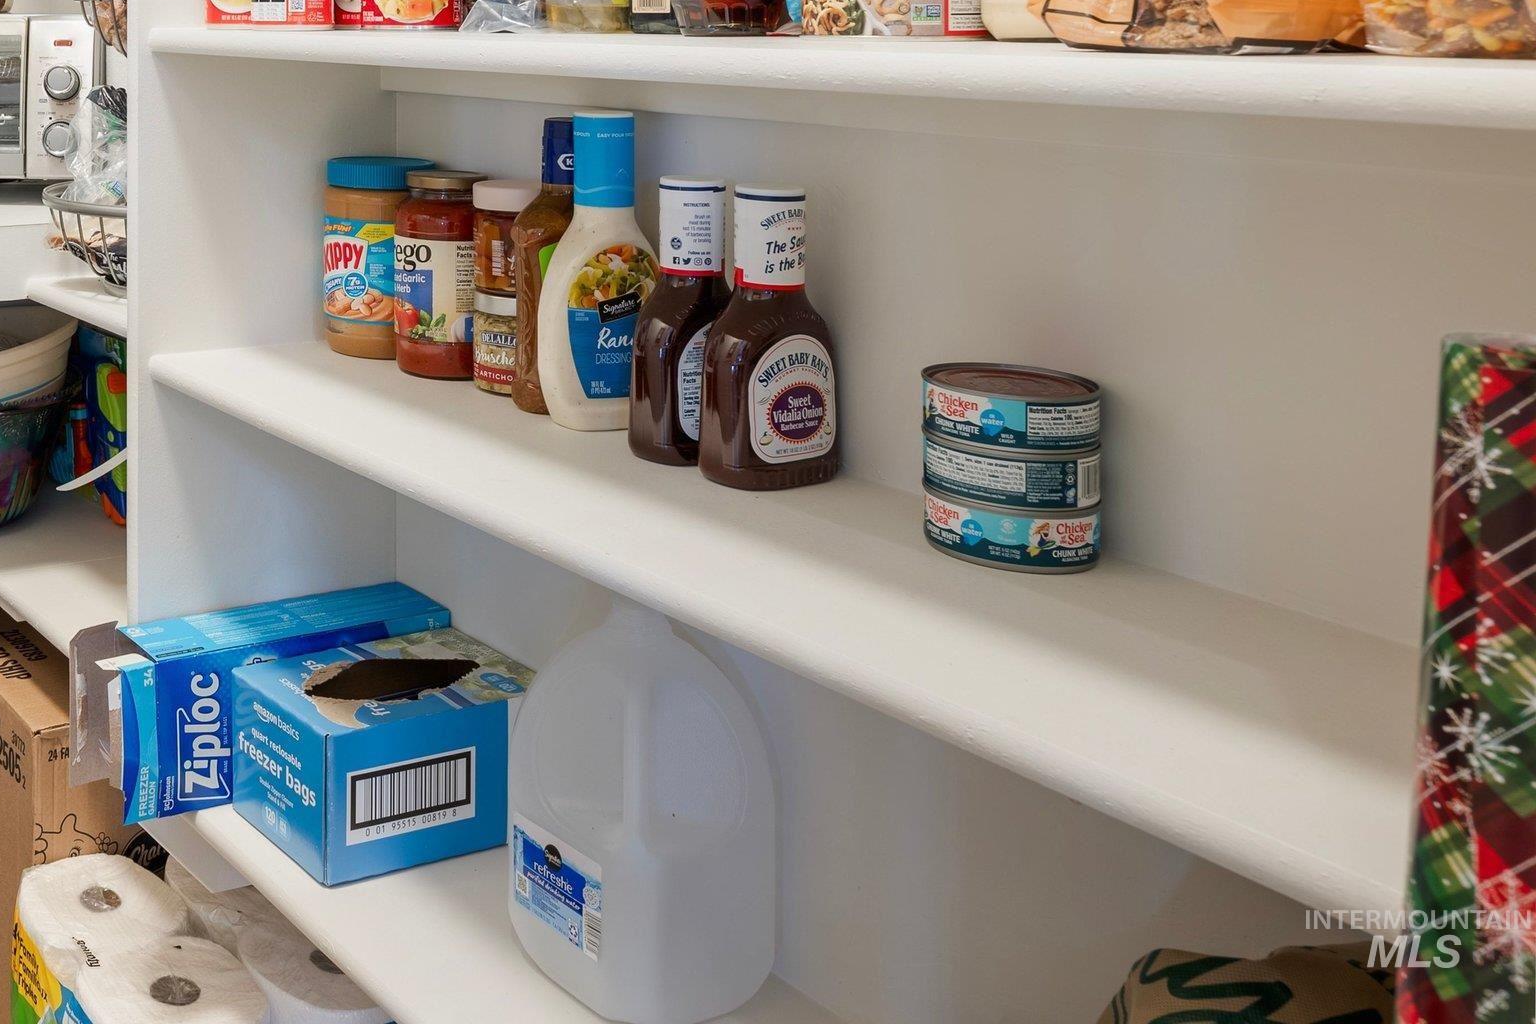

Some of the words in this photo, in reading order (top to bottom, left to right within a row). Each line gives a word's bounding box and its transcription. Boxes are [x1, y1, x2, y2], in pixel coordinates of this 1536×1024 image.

[759, 209, 786, 231] SWEET
[766, 241, 787, 255] The
[765, 259, 775, 274] is
[779, 255, 796, 271] the
[402, 273, 426, 283] Garlic
[603, 298, 636, 314] Signature
[595, 352, 632, 365] DRESSING
[758, 357, 786, 388] SWEET
[787, 352, 810, 367] BABY
[811, 354, 830, 379] RAY'S
[787, 394, 812, 409] Sweet
[937, 391, 979, 412] Chicken
[773, 409, 802, 424] Vidalia
[803, 405, 823, 420] Onion
[946, 405, 965, 419] Sea
[780, 422, 805, 432] Barbecue
[805, 419, 819, 428] Sauce
[934, 416, 956, 429] CHUNK
[956, 422, 980, 435] WHITE
[980, 417, 1005, 427] water
[928, 497, 960, 520] Chicken
[934, 513, 949, 526] Sea
[1056, 521, 1093, 536] Chicken
[941, 531, 961, 544] WHITE
[1068, 533, 1086, 546] Sea
[1052, 549, 1077, 558] CHUNK
[1077, 547, 1093, 555] WHITE
[144, 668, 154, 687] 34
[183, 671, 231, 794] Ziploc
[251, 727, 269, 746] quart
[269, 739, 302, 771] reclosable
[238, 730, 283, 779] freezer
[285, 764, 317, 807] bags
[138, 765, 150, 817] FREEZER
[147, 780, 156, 816] GALLON
[375, 825, 386, 835] 01
[390, 819, 417, 833] 95515
[422, 814, 447, 828] 00819
[533, 861, 573, 895] refreshe
[544, 882, 565, 903] drinking
[565, 897, 581, 911] water
[19, 936, 40, 974] Family
[16, 972, 39, 1006] Triples
